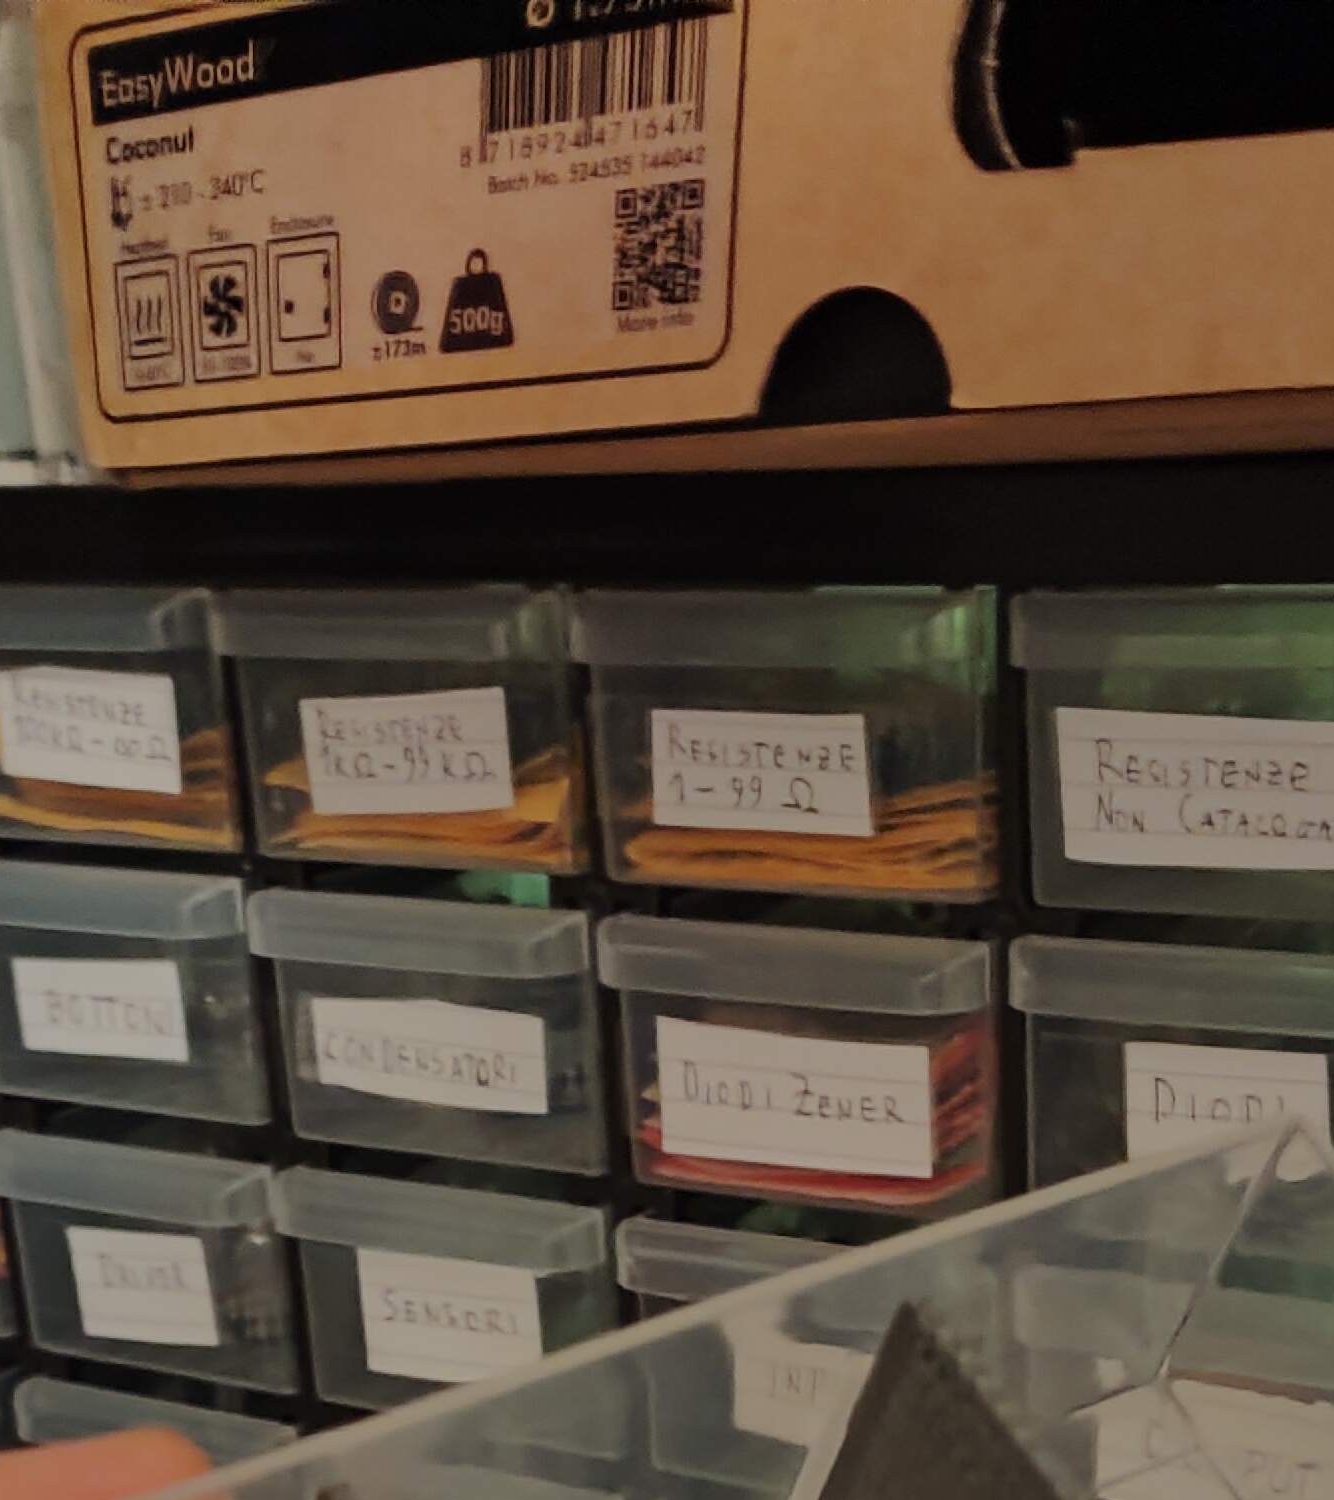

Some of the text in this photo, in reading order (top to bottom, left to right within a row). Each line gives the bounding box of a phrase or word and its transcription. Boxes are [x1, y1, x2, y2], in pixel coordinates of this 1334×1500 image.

[99, 38, 255, 110] EasyWood
[107, 125, 195, 164] Coconut
[449, 306, 504, 337] 500g
[1095, 737, 1310, 793] RESISTENZE
[324, 1032, 517, 1087] CONDENSATORI
[787, 1071, 905, 1123] ZENER
[383, 1288, 519, 1336] SENSORI
